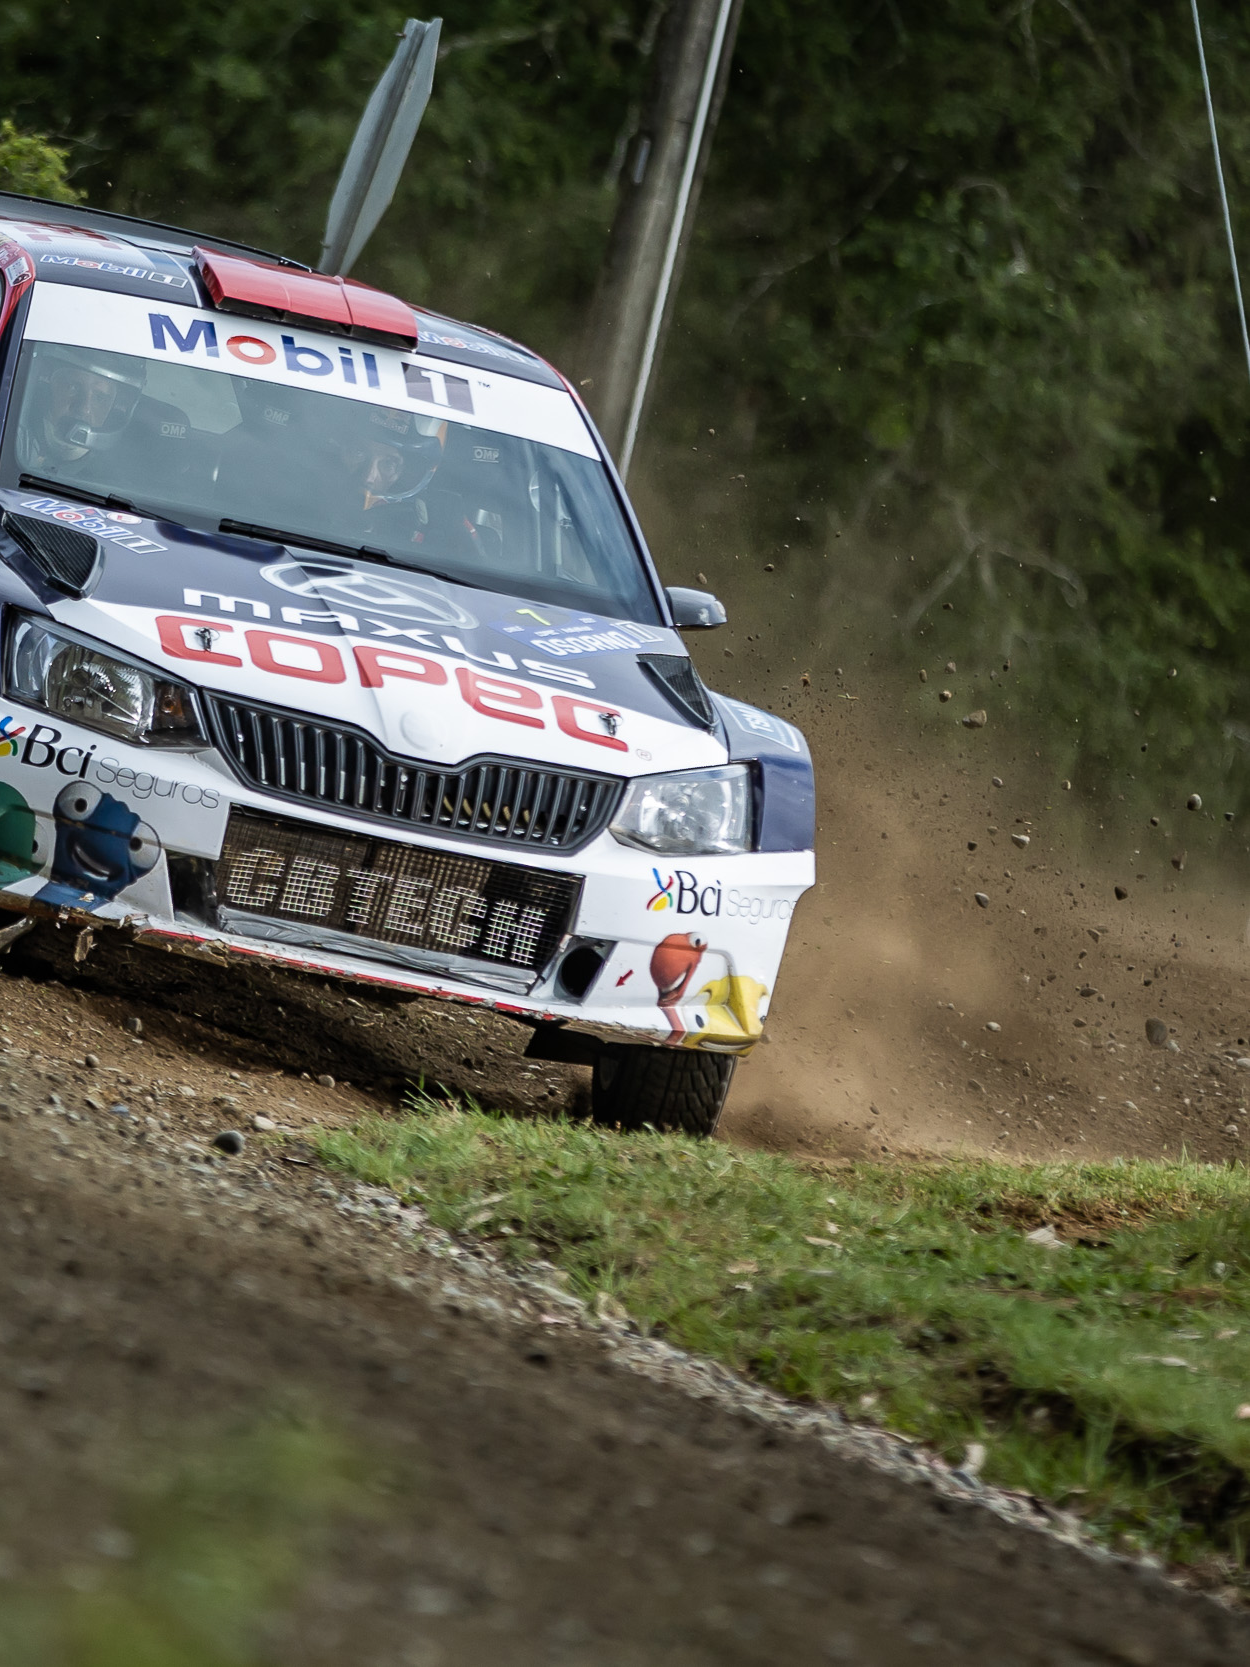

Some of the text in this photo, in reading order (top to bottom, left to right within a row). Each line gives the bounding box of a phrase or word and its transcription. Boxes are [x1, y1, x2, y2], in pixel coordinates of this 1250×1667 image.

[40, 254, 147, 279] Mobil
[148, 313, 381, 389] Mobil
[161, 424, 187, 437] OMP
[263, 408, 290, 425] OMP
[474, 449, 500, 461] OMP
[20, 498, 129, 541] Mobil
[183, 588, 597, 690] MAXUS
[530, 630, 642, 656] OSORNO
[155, 615, 629, 752] COPEC
[20, 724, 221, 809] Bci Seguros
[674, 870, 722, 917] Bci
